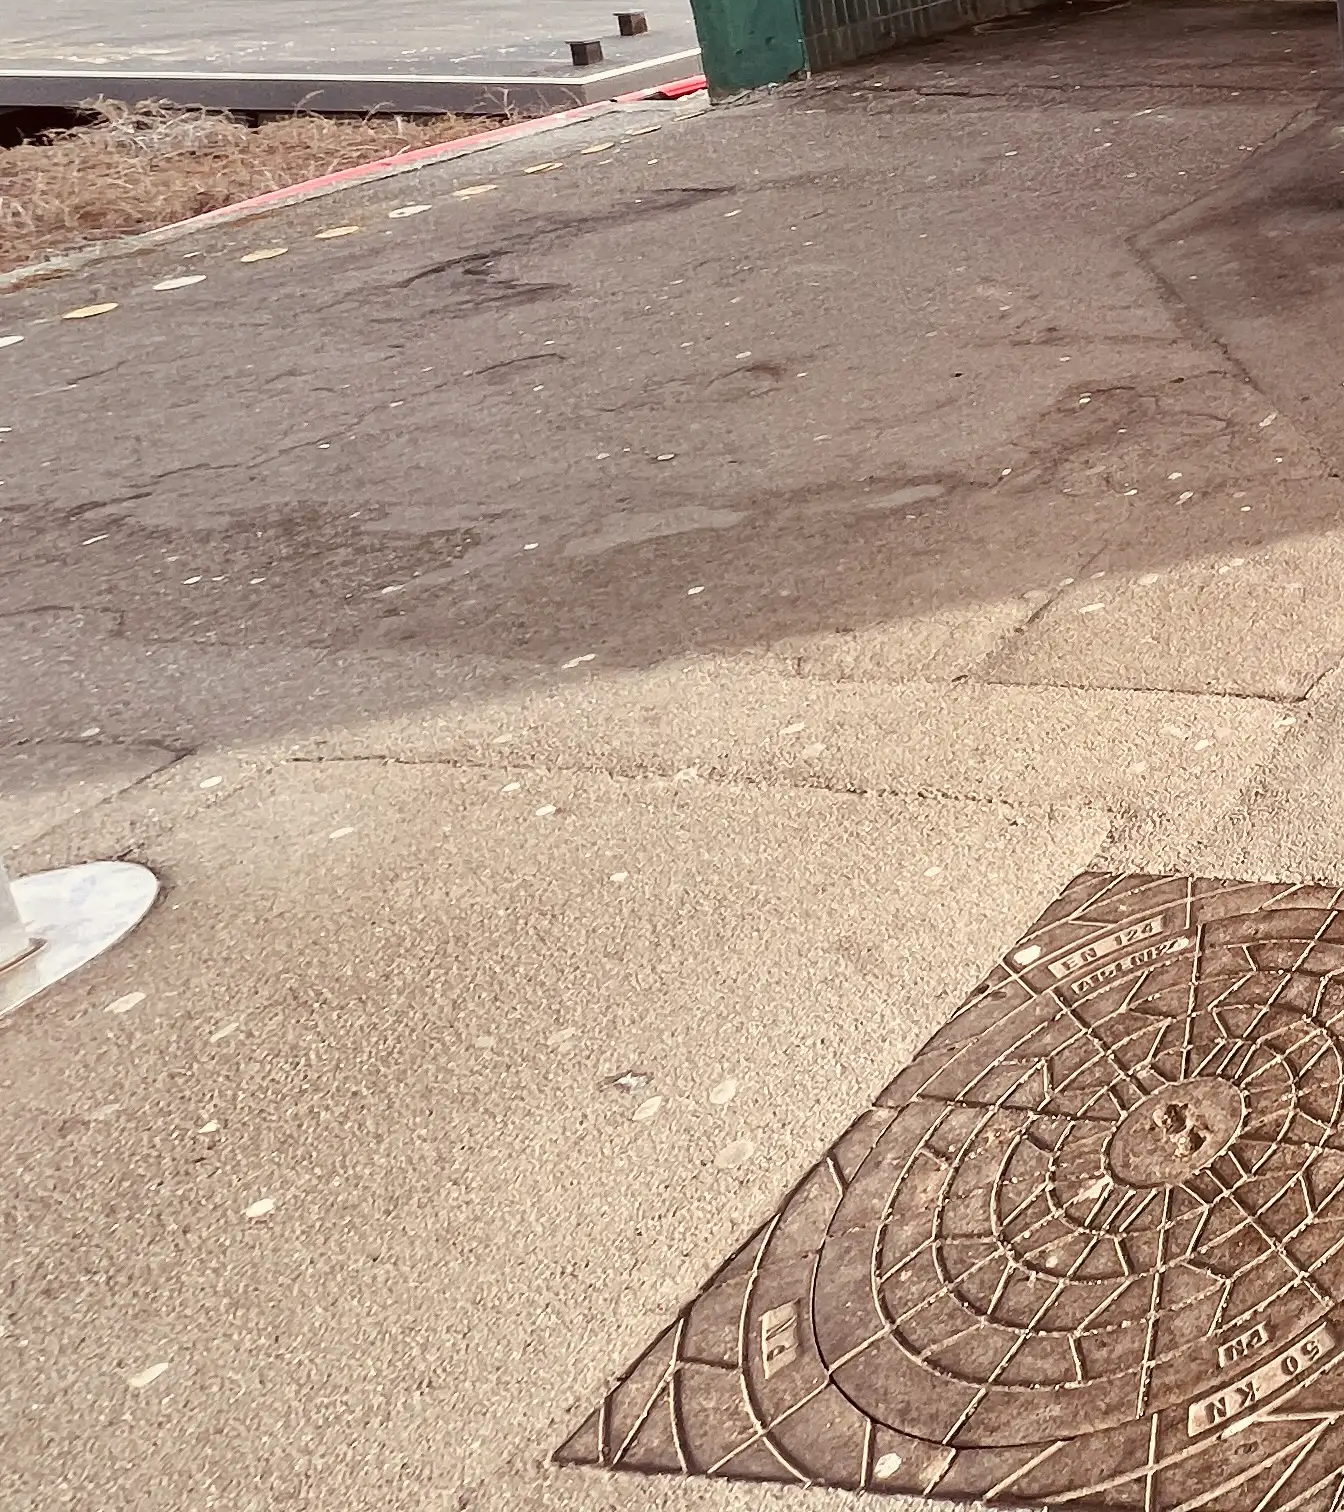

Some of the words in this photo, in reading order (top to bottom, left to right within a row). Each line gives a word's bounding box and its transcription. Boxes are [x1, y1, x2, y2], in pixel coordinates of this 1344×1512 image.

[1060, 946, 1098, 972] EN
[1113, 919, 1156, 947] 124
[1280, 1339, 1321, 1376] 50
